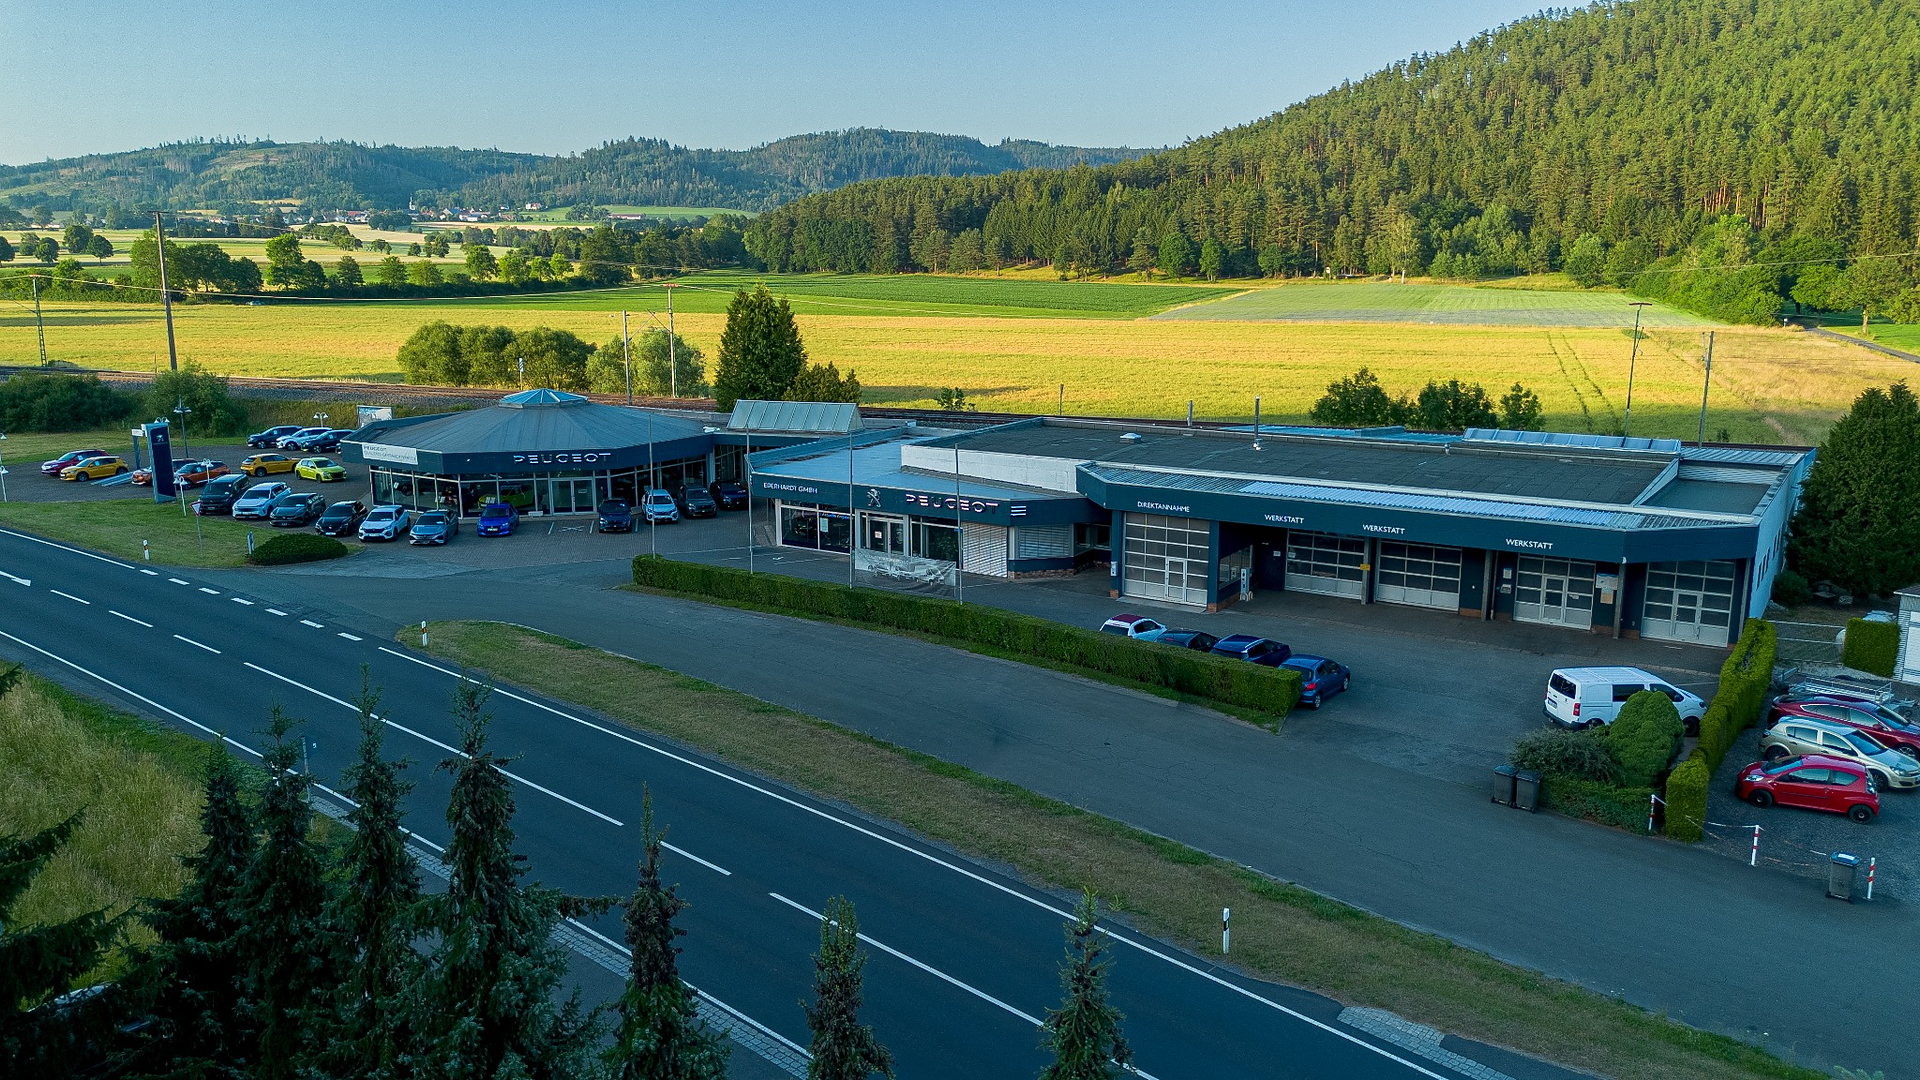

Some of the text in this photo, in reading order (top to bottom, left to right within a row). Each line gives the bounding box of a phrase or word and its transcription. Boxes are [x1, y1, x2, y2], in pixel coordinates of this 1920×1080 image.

[513, 453, 611, 464] PEUGEOT
[905, 493, 998, 514] PEUGEOT
[1137, 500, 1190, 513] DIREKTANNAHME
[1264, 514, 1304, 524] WERKSTATT
[1362, 524, 1405, 534] WERKSTATT
[1505, 538, 1553, 550] WERKSTATT
